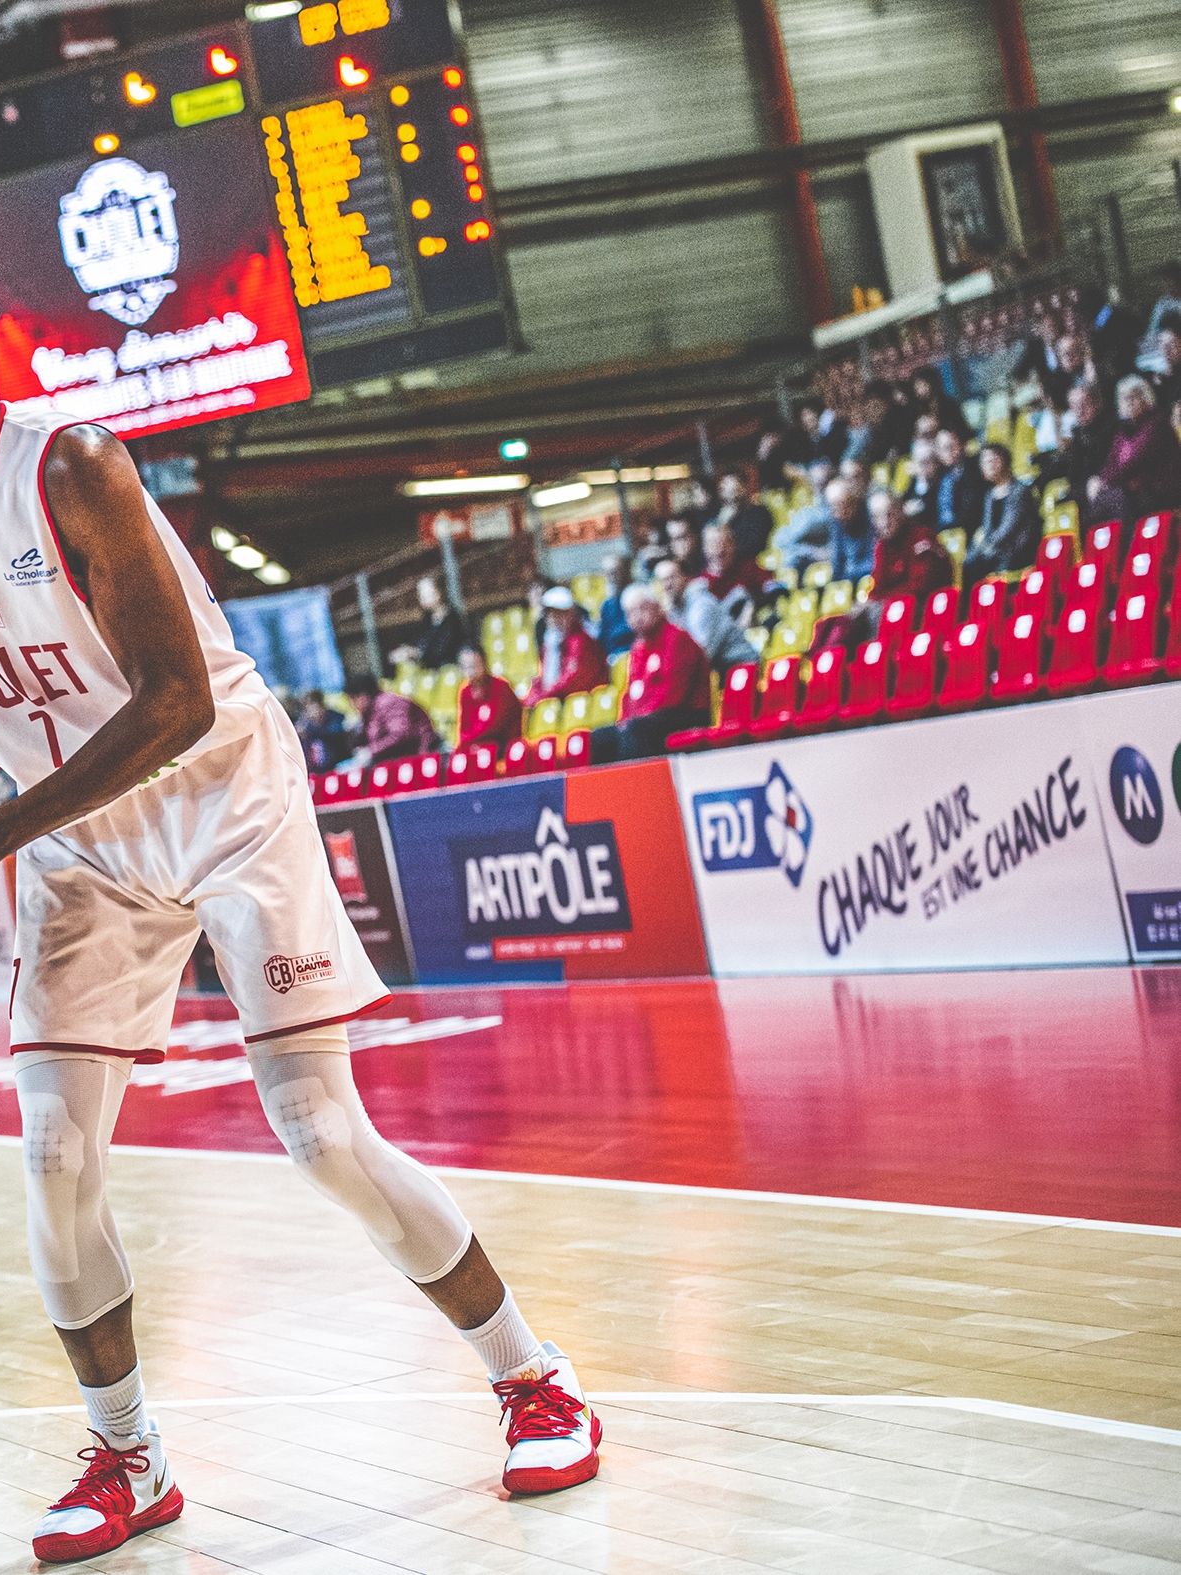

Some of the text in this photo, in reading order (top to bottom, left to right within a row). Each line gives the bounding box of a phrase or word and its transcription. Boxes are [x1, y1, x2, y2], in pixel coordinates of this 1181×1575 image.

[3, 572, 15, 581] Le
[28, 710, 64, 769] 7
[699, 799, 756, 861] FDJ
[921, 756, 1087, 920] EST UNE CHANCE
[818, 783, 980, 957] CHAQUE JOUR
[268, 962, 292, 987] CB
